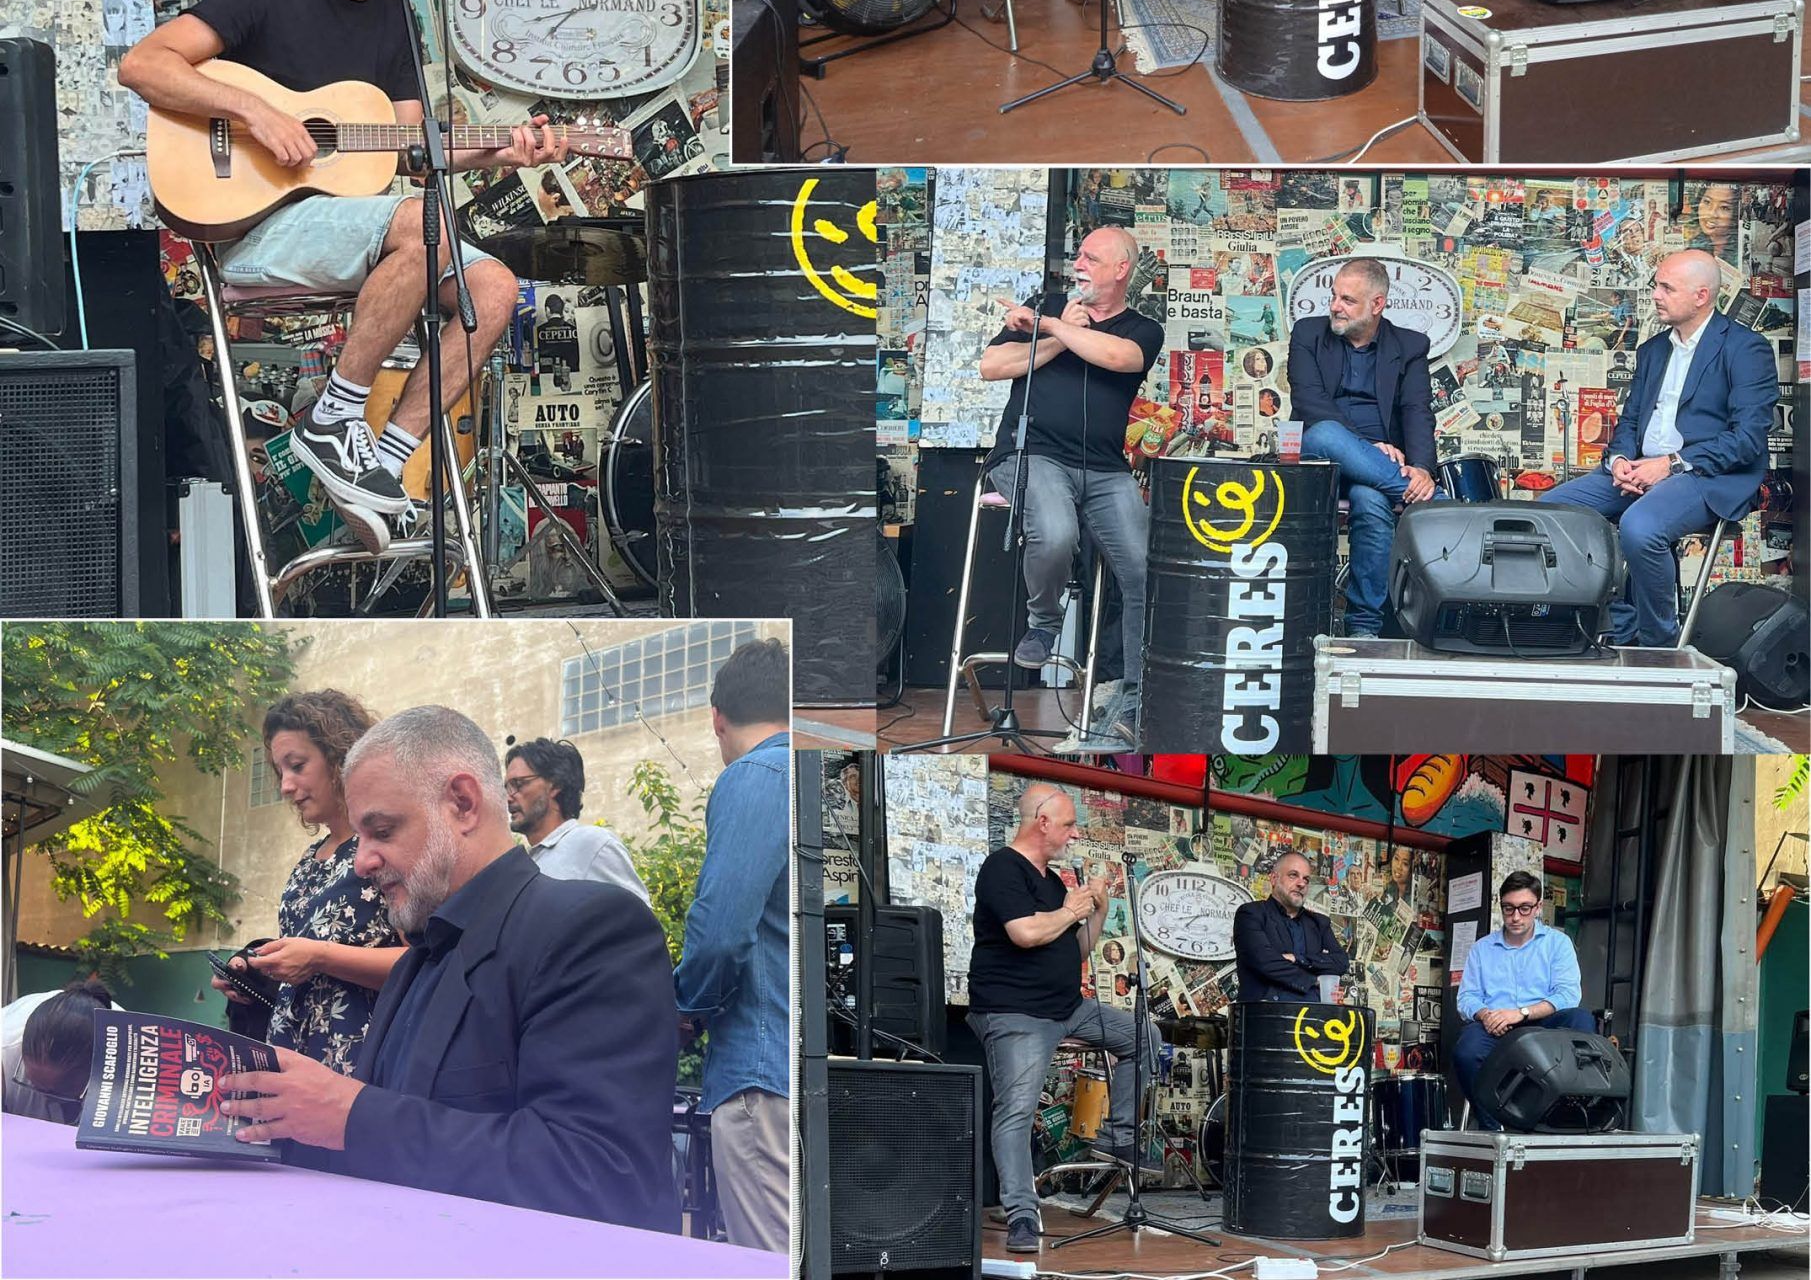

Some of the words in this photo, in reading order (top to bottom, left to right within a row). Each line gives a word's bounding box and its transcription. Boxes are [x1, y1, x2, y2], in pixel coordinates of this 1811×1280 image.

[660, 3, 683, 27] 3
[491, 39, 517, 64] 8
[529, 55, 557, 80] 7
[563, 61, 588, 86] 6
[597, 59, 621, 83] 5
[1227, 241, 1258, 253] Giulia
[1417, 276, 1433, 292] 2
[1168, 289, 1213, 305] Braun,
[1167, 308, 1177, 318] e
[1181, 305, 1223, 319] basta
[1297, 299, 1315, 314] 9
[1435, 304, 1452, 320] 3
[304, 330, 313, 341] LA
[535, 404, 580, 422] AUTO
[1220, 541, 1288, 755] CERES
[1088, 849, 1111, 861] Giulia
[1160, 902, 1179, 913] CHEF
[1180, 904, 1192, 914] LE
[103, 1025, 118, 1080] SCAFOGLIO
[128, 1025, 159, 1135] INTELLIGENZA
[150, 1026, 182, 1137] CRIMINALE
[93, 1080, 114, 1128] GIOVANNI
[1170, 1102, 1192, 1110] AUTO
[178, 1118, 186, 1135] FAKE
[1329, 1066, 1366, 1223] CERES
